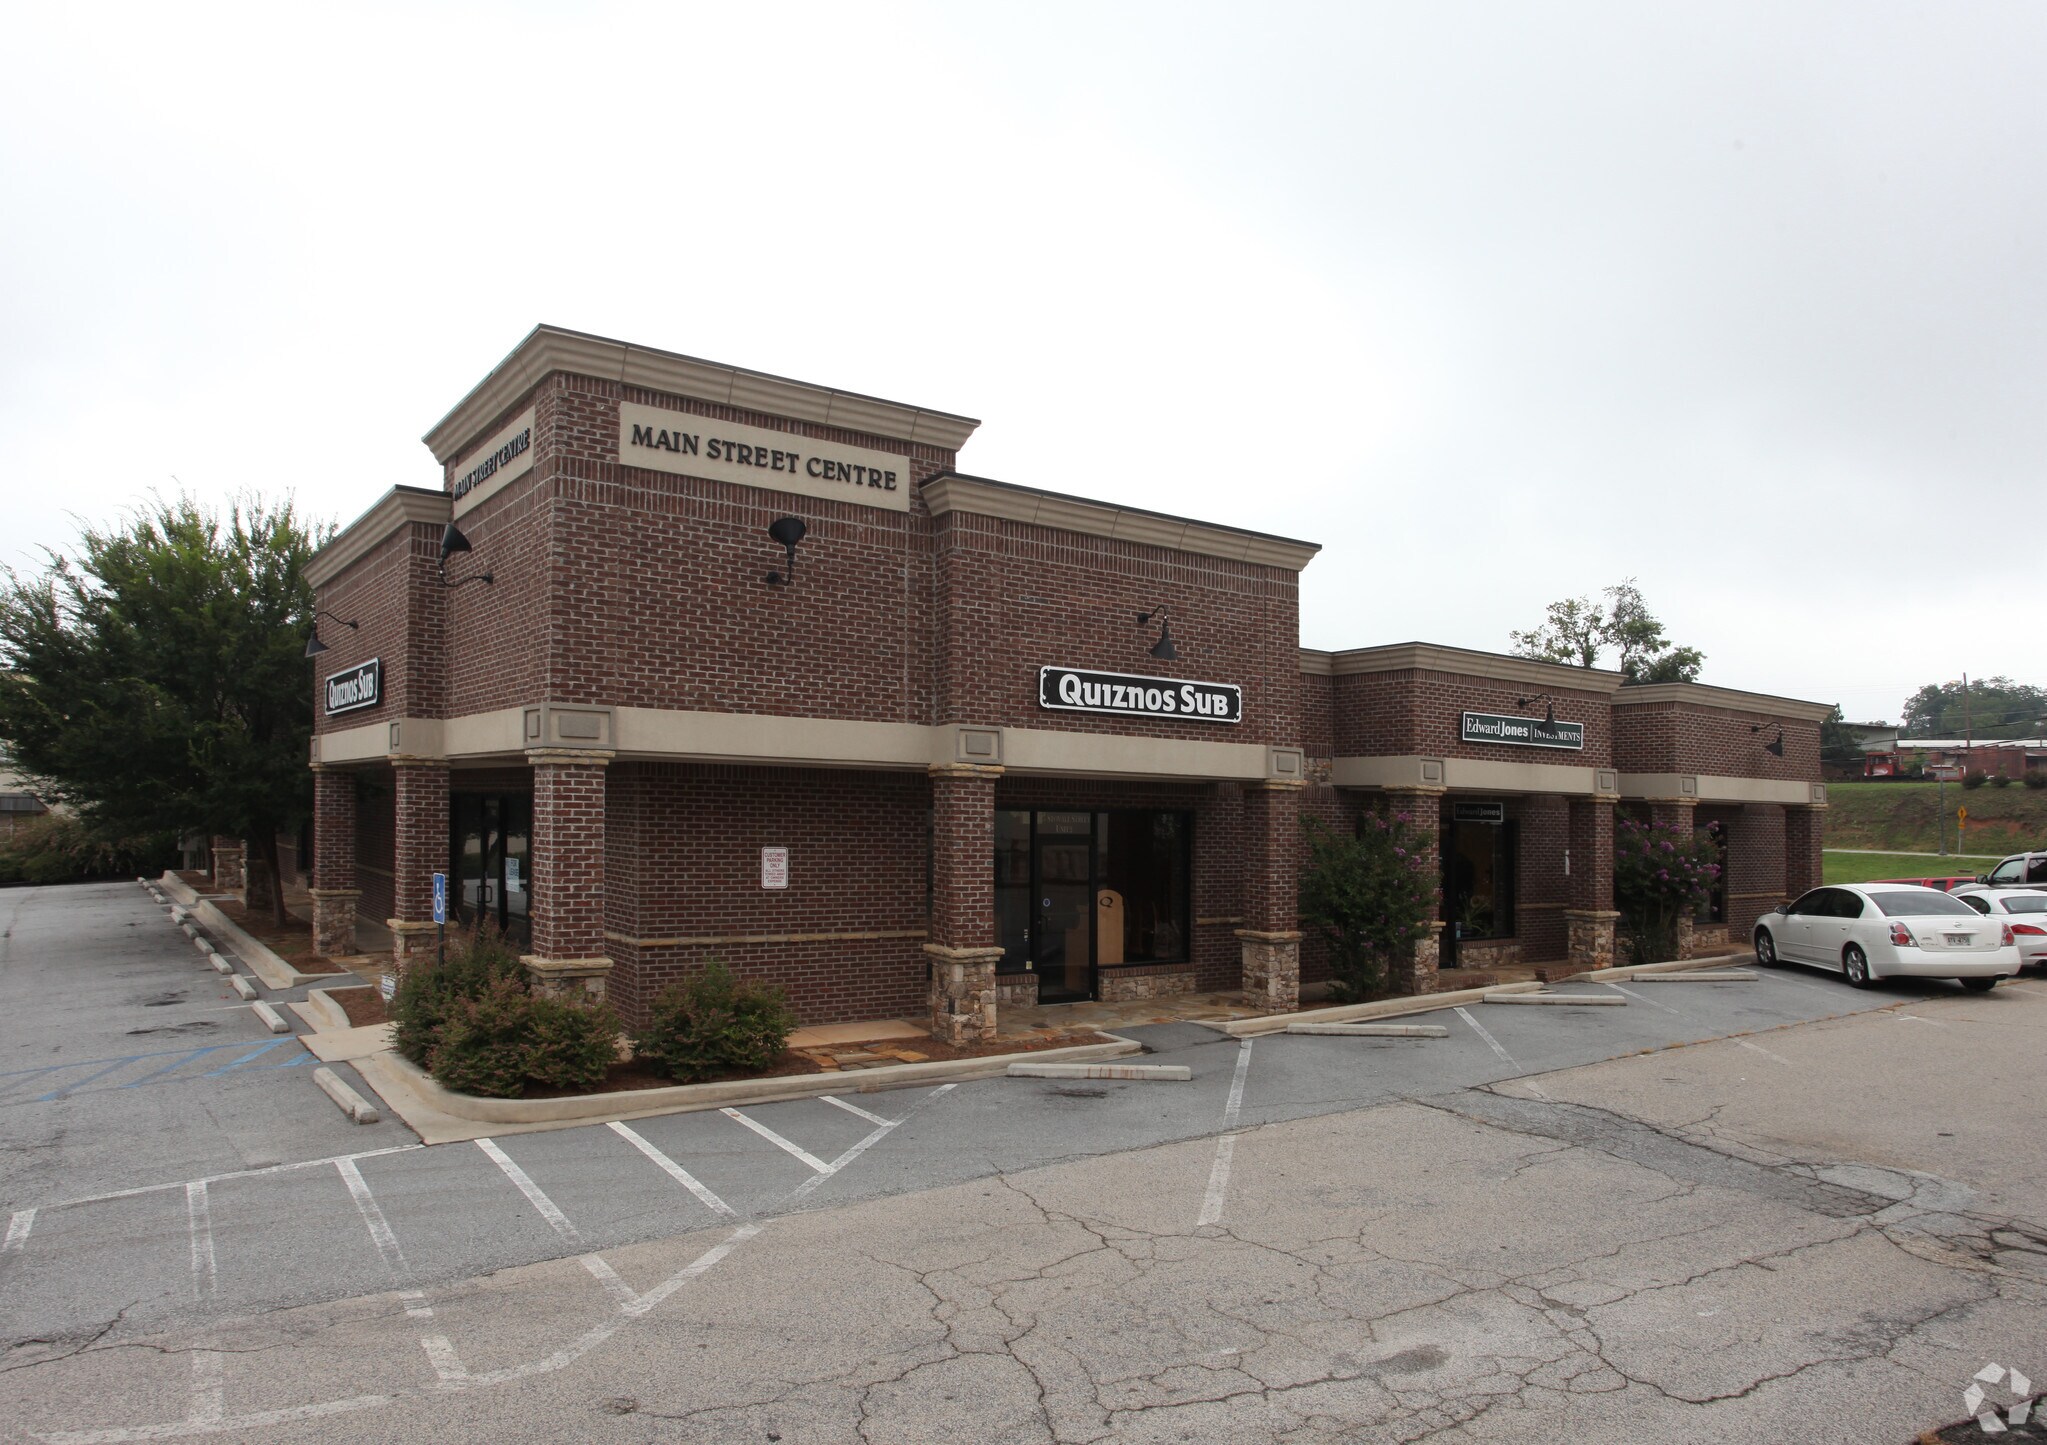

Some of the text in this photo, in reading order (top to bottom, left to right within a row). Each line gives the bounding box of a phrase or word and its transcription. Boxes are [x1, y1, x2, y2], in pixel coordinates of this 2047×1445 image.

[631, 424, 898, 490] MAIN STREET CENTRE
[454, 473, 472, 502] MAIN
[1466, 717, 1500, 735] Edward
[1500, 721, 1529, 737] Jones
[1480, 808, 1500, 816] Jones
